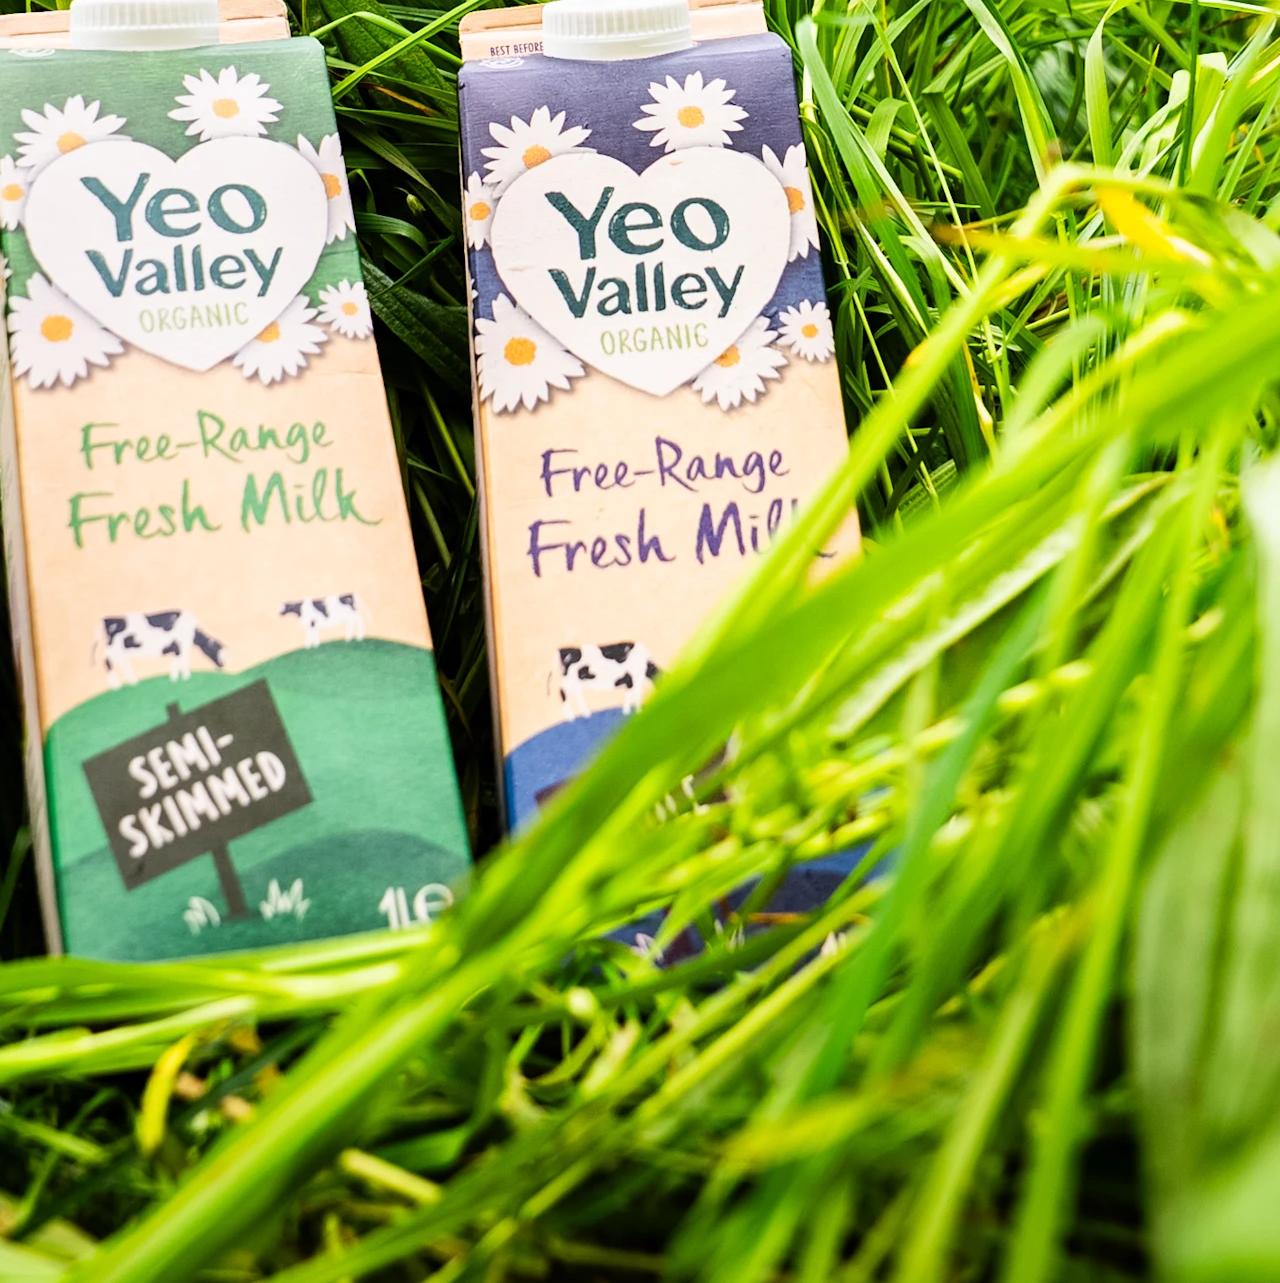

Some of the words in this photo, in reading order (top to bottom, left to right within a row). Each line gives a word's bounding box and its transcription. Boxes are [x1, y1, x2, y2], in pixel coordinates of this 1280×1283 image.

[489, 44, 511, 57] BEST
[513, 41, 544, 54] BEFORE
[79, 172, 268, 242] Yeo
[544, 186, 731, 261] Yeo
[84, 244, 284, 298] Valley
[547, 261, 746, 319] Valley
[138, 301, 250, 334] ORGANIC
[599, 322, 710, 356] ORGANIC
[80, 409, 335, 470] Free-Range
[540, 435, 790, 497] Free-Range
[67, 478, 222, 549] Fresh
[240, 467, 384, 534] Milk
[527, 507, 675, 578] Fresh
[128, 725, 234, 799] SEMI-
[118, 750, 287, 859] SKIMMED
